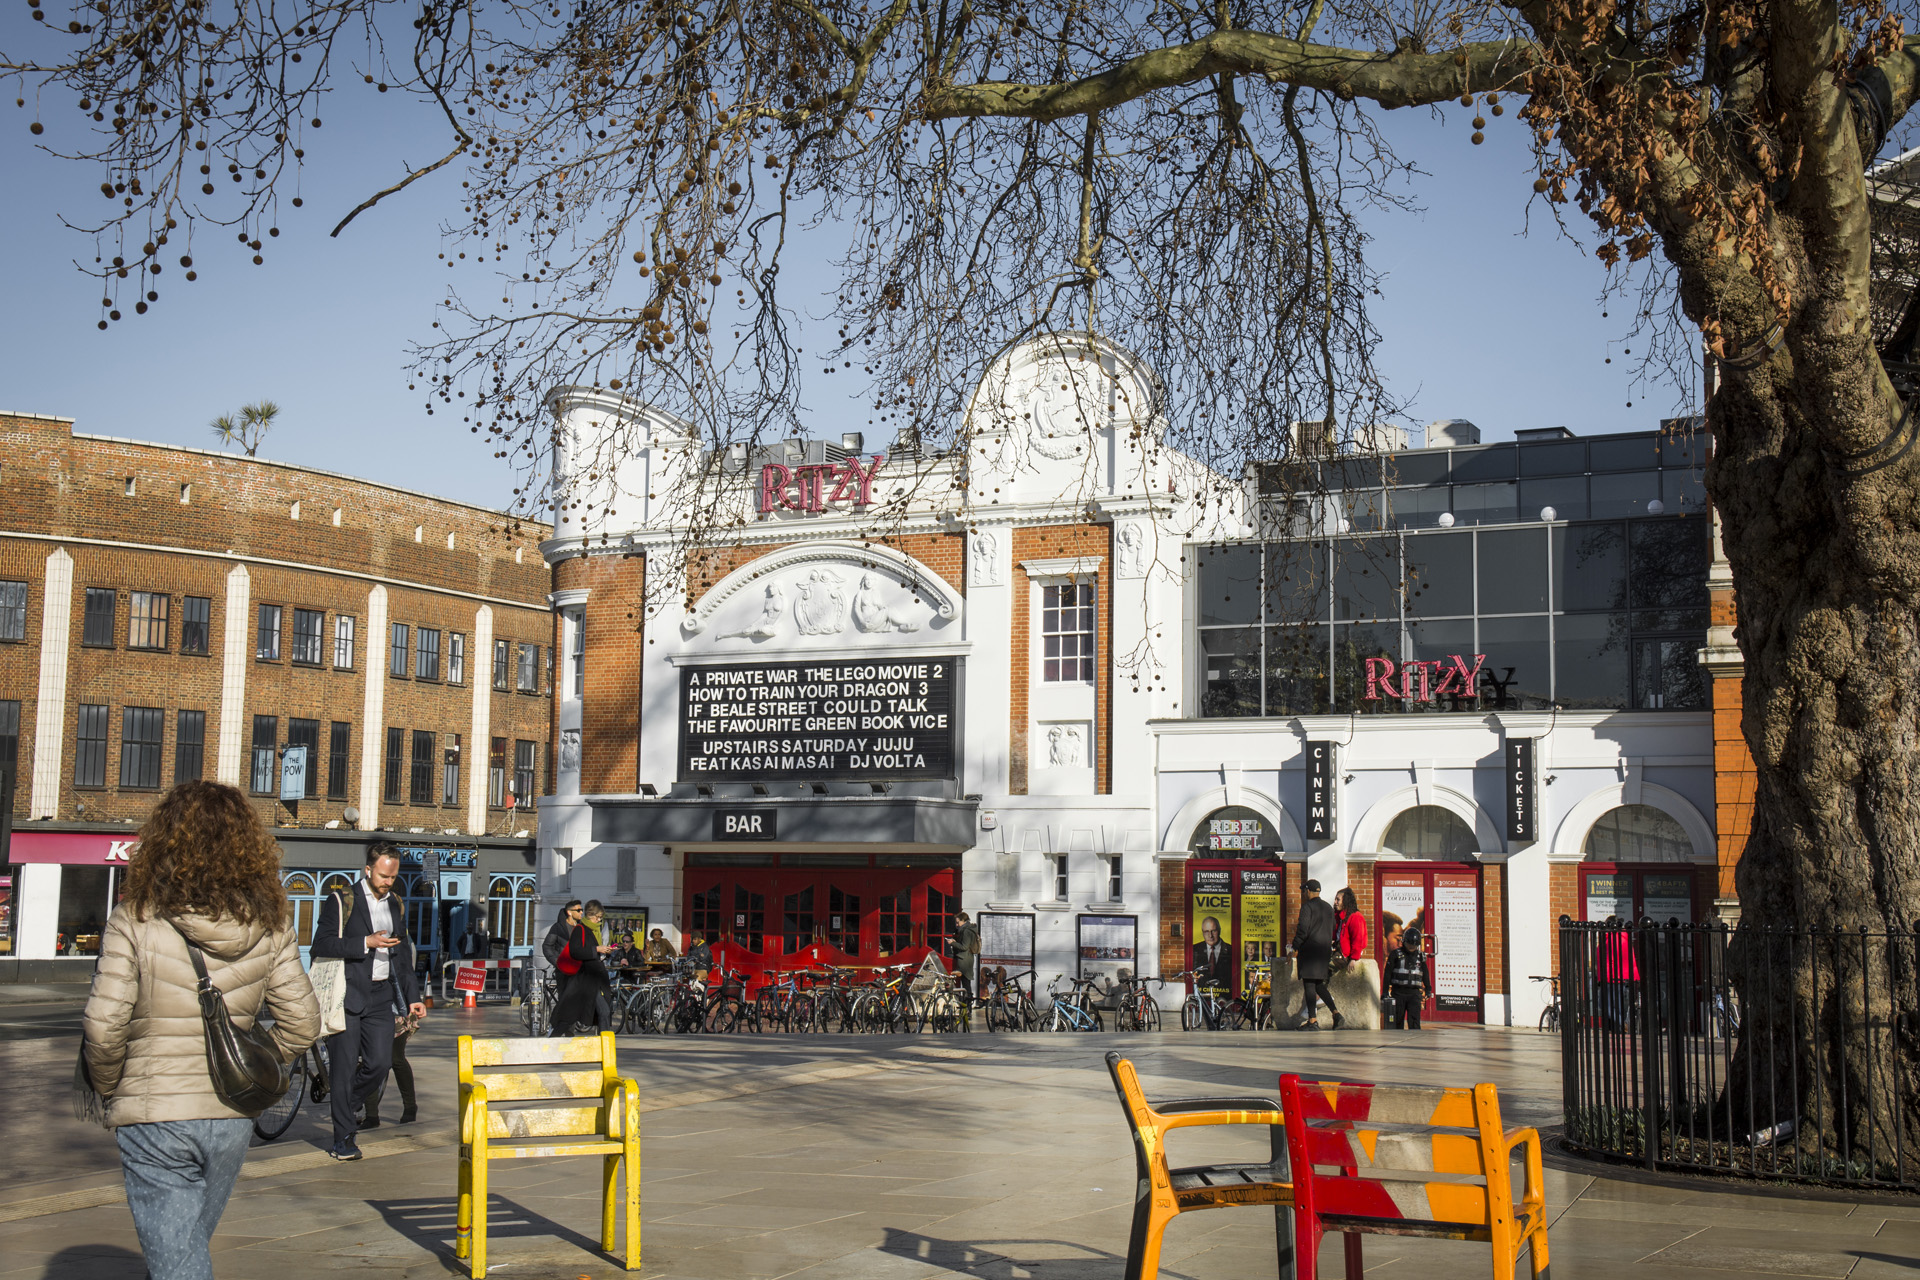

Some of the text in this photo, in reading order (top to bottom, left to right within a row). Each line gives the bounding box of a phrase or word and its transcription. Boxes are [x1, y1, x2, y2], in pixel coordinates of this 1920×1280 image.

[690, 665, 943, 685] A PRIVATE WAR THE LEGO MOVIE 2
[689, 681, 928, 702] HOW TO TRAIN YOUR DRAGON 3
[689, 698, 928, 717] IF BEALE STREET COULD TALK
[688, 714, 947, 734] THE FAVOURITE GREEN BOOK VICE
[703, 737, 914, 755] UPSTAIRS SATURDAY JUJU
[285, 765, 302, 776] POW
[690, 754, 926, 771] FEAT KASAI MASAI DJ VOLTA
[1312, 748, 1324, 833] CINEMA
[1514, 745, 1524, 834] TICKETS
[725, 815, 763, 833] BAR
[1210, 820, 1262, 834] REBEL
[1210, 835, 1262, 850] REBEL
[1196, 896, 1230, 907] VICE
